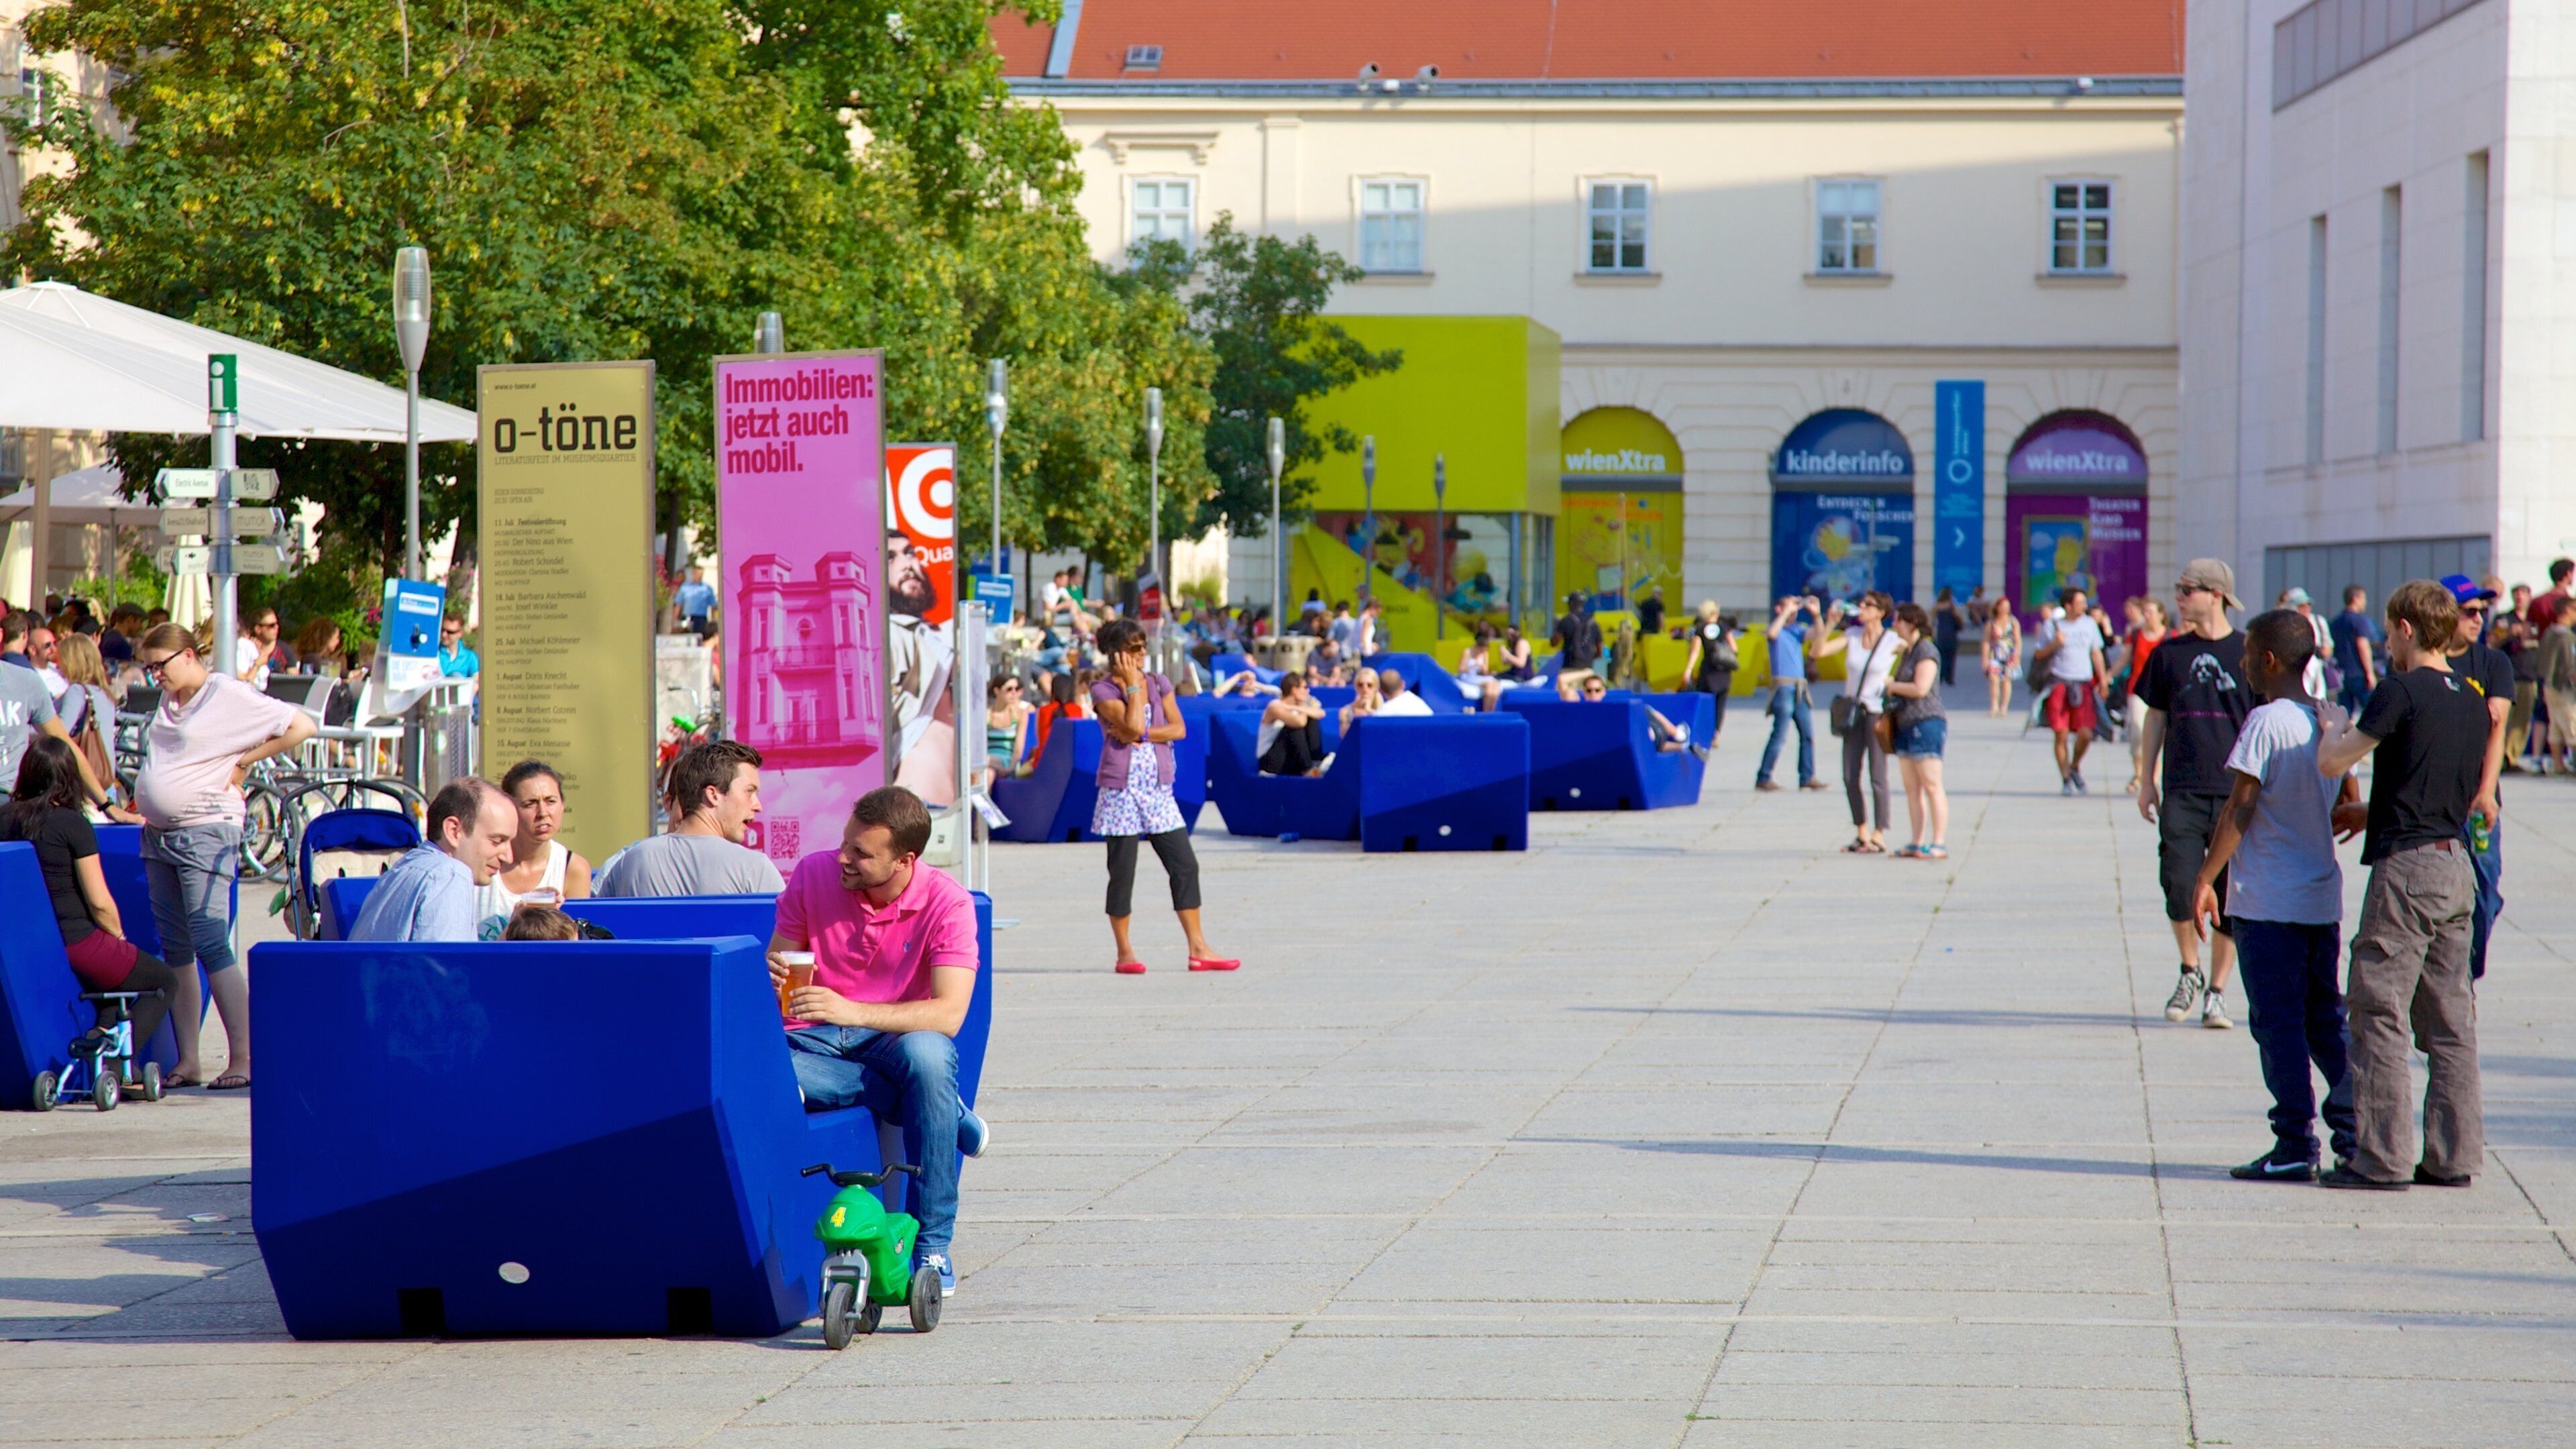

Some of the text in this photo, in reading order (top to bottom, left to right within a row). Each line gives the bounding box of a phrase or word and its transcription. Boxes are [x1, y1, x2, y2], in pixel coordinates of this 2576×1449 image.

[726, 368, 873, 404] Immobilien:
[494, 402, 637, 453] o-töne
[725, 404, 849, 446] jetzt auch
[494, 453, 637, 465] LITERATURFEST IM MUSEUMSQUARTIER
[728, 441, 804, 474] mobil.
[1565, 448, 1666, 472] wienXtra
[1786, 449, 1904, 473] kinderinfo
[2026, 449, 2129, 472] wienXtra
[237, 514, 266, 527] mumok
[526, 537, 541, 545] Nino
[556, 537, 574, 545] Wien
[513, 558, 534, 566] Robert
[536, 556, 564, 565] Schindel
[518, 592, 544, 600] Barbara
[546, 590, 586, 600] Aschenwald
[516, 603, 531, 611] Josef
[520, 636, 545, 645] Michael
[547, 636, 581, 645] Köhlmeier
[502, 673, 522, 682] August
[525, 672, 543, 680] Doris
[544, 672, 567, 680] Knecht
[503, 706, 523, 715] August
[526, 706, 551, 714] Norbert
[553, 706, 576, 714] Gstrein
[507, 739, 527, 749] August
[543, 739, 571, 747] Menasse
[830, 1206, 847, 1228] 4
